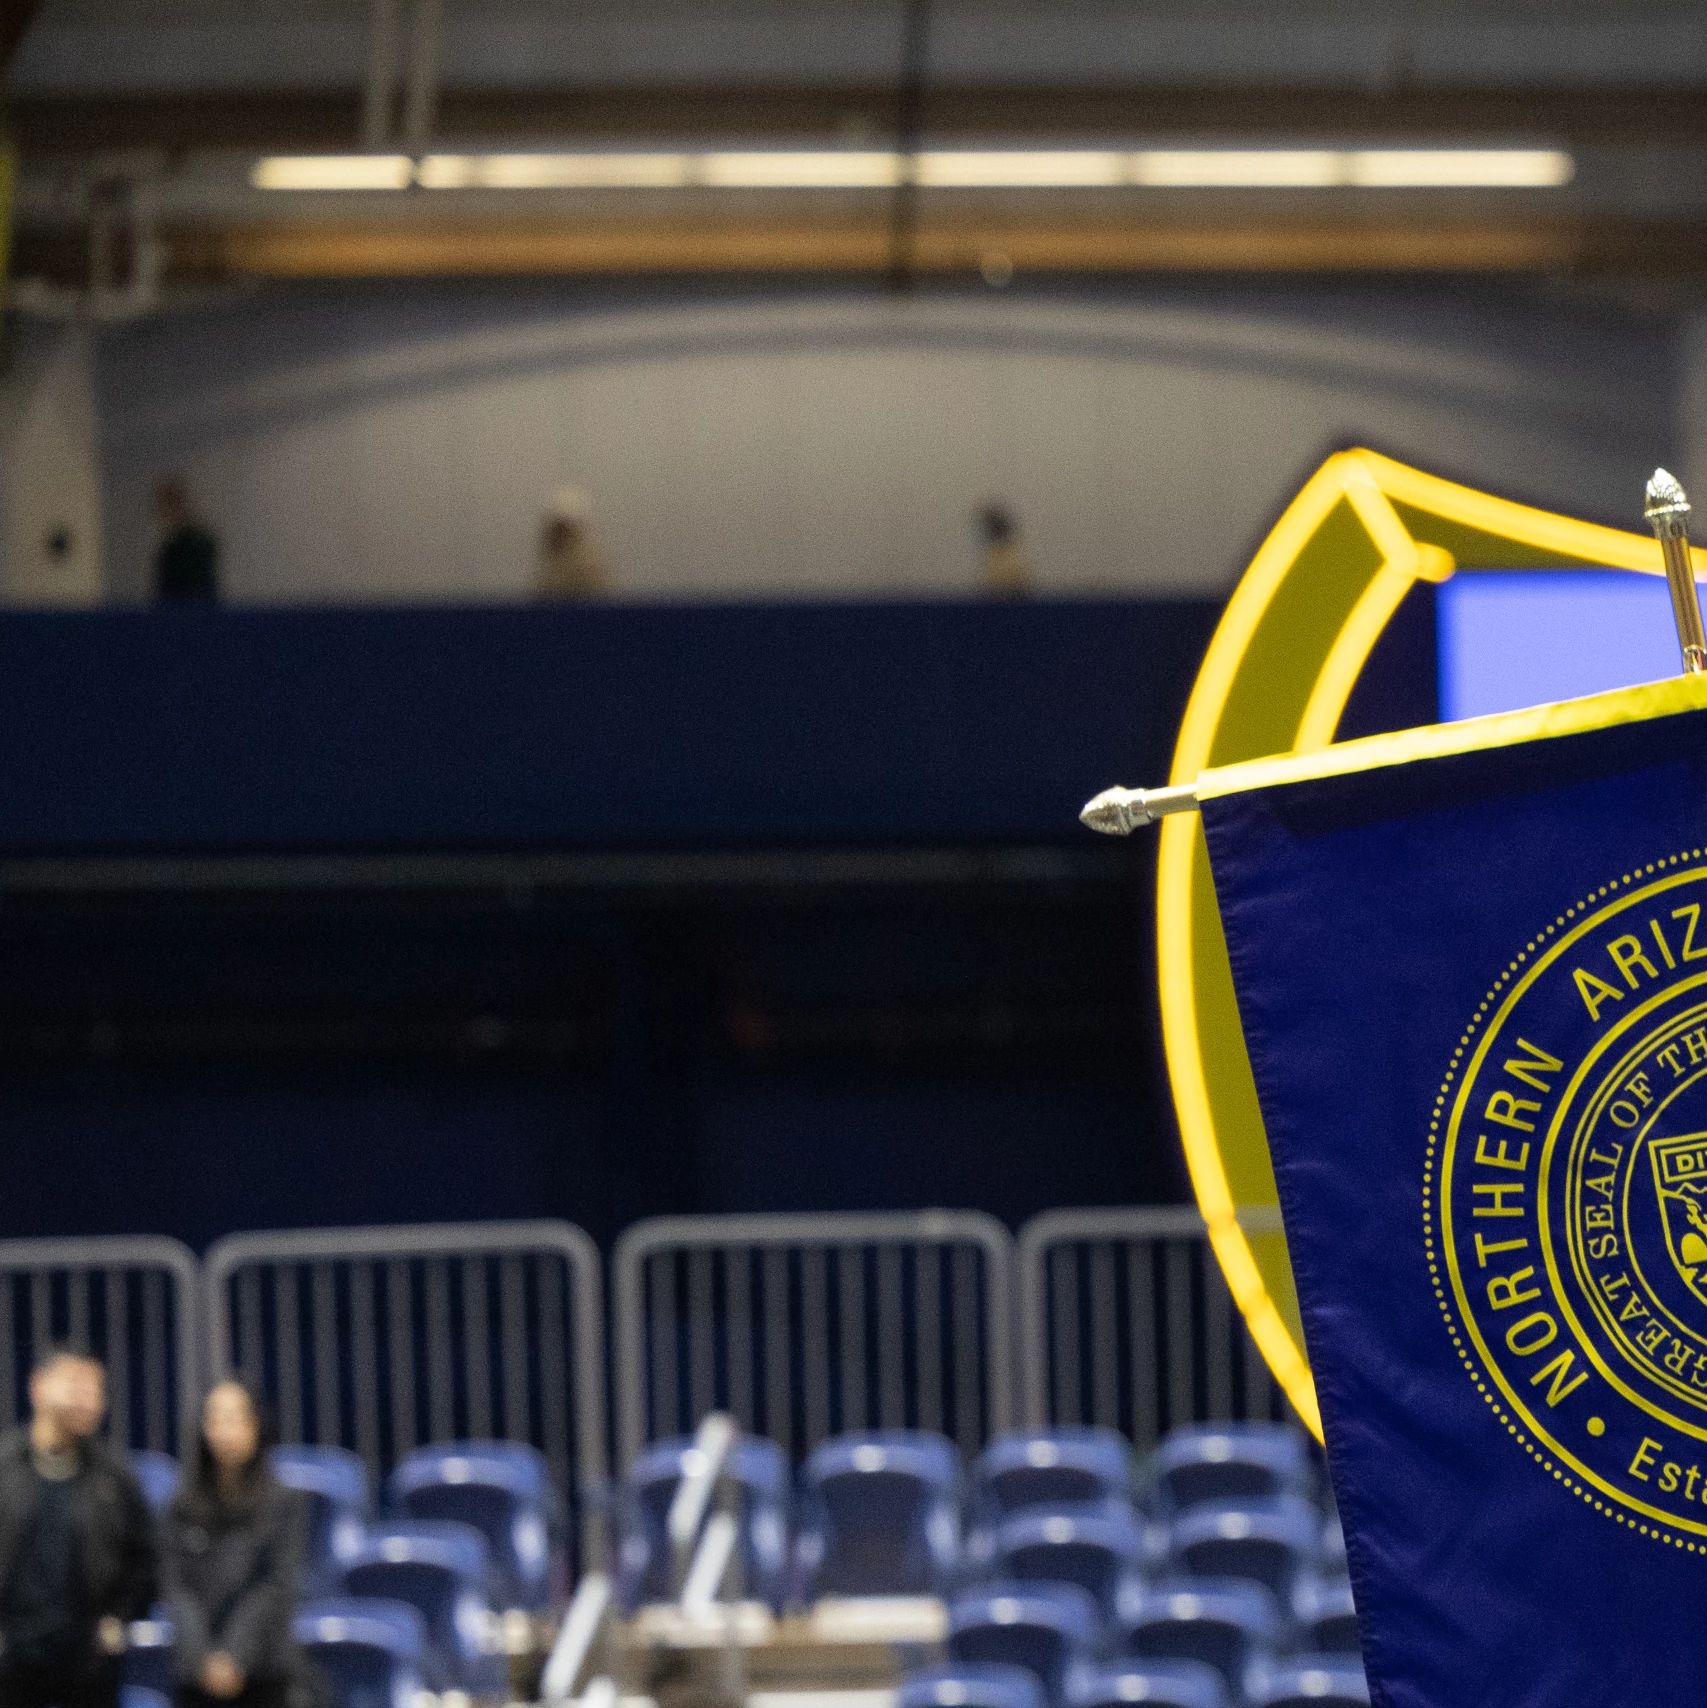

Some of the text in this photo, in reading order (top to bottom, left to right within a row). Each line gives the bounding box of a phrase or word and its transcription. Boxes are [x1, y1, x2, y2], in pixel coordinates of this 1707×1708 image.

[1472, 1038, 1588, 1407] NORTHERN
[1585, 1138, 1622, 1258] SEAL
[1609, 1079, 1654, 1128] OF
